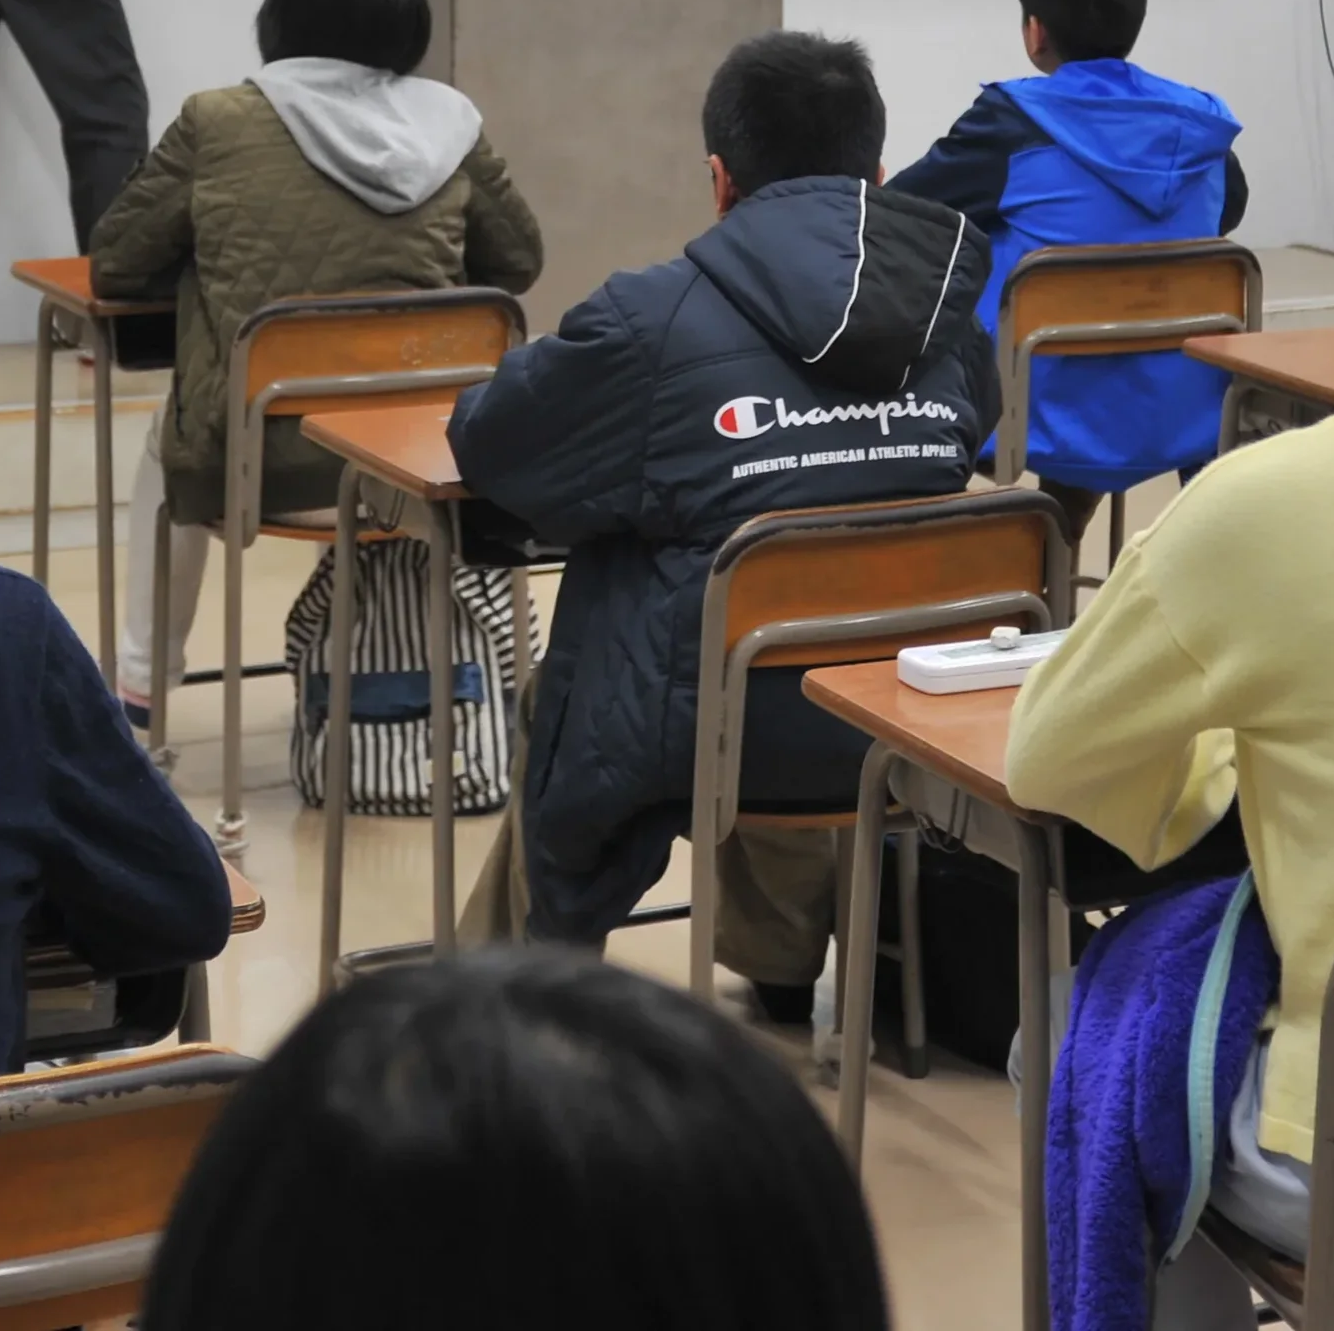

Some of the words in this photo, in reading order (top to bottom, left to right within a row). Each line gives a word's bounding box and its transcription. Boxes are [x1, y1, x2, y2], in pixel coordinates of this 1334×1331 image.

[714, 392, 958, 440] Champion
[732, 454, 798, 479] AUTHENTIC
[801, 448, 866, 467] AMERICAN
[868, 445, 920, 461] ATHLETIC
[922, 444, 958, 458] APPAREL
